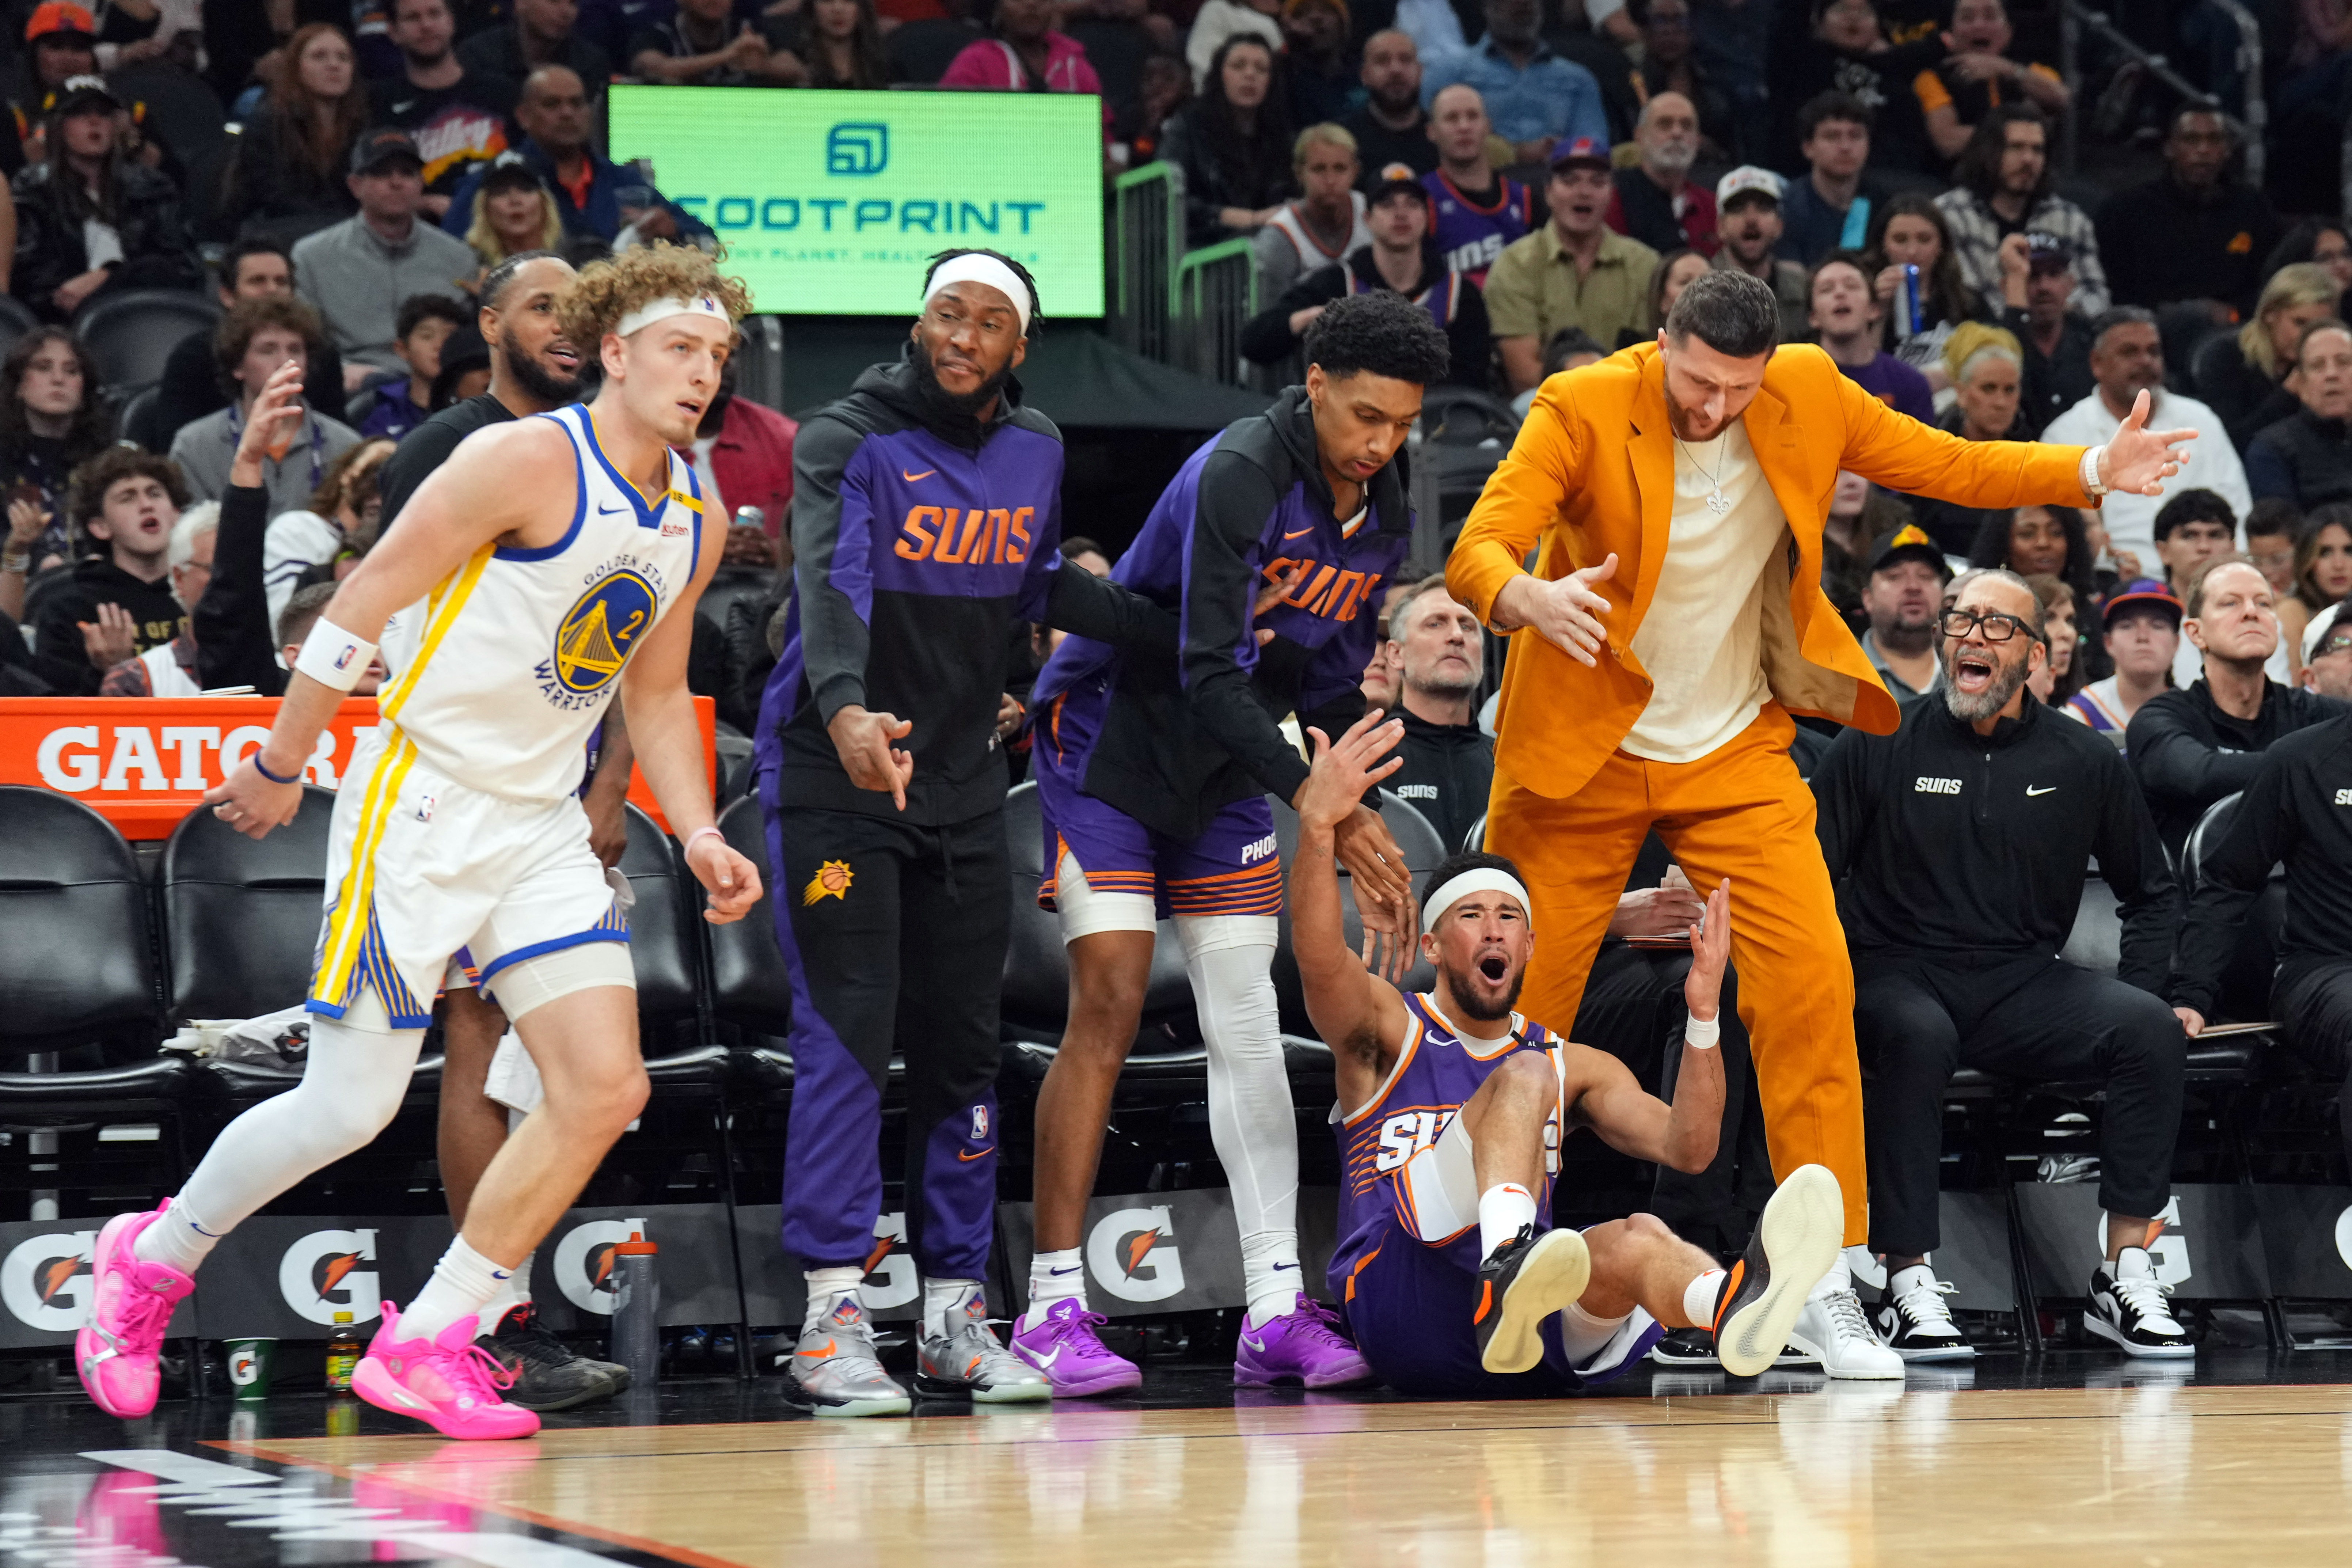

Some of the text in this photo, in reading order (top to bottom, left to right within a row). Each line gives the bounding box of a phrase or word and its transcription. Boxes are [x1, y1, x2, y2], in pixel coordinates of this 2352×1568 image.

[894, 504, 1034, 564] SUNS
[584, 554, 639, 585] GOLDEN
[616, 610, 644, 639] 2
[1, 1230, 96, 1332] G
[279, 1229, 381, 1326] G
[1087, 1205, 1186, 1302] G
[228, 1350, 258, 1386] G
